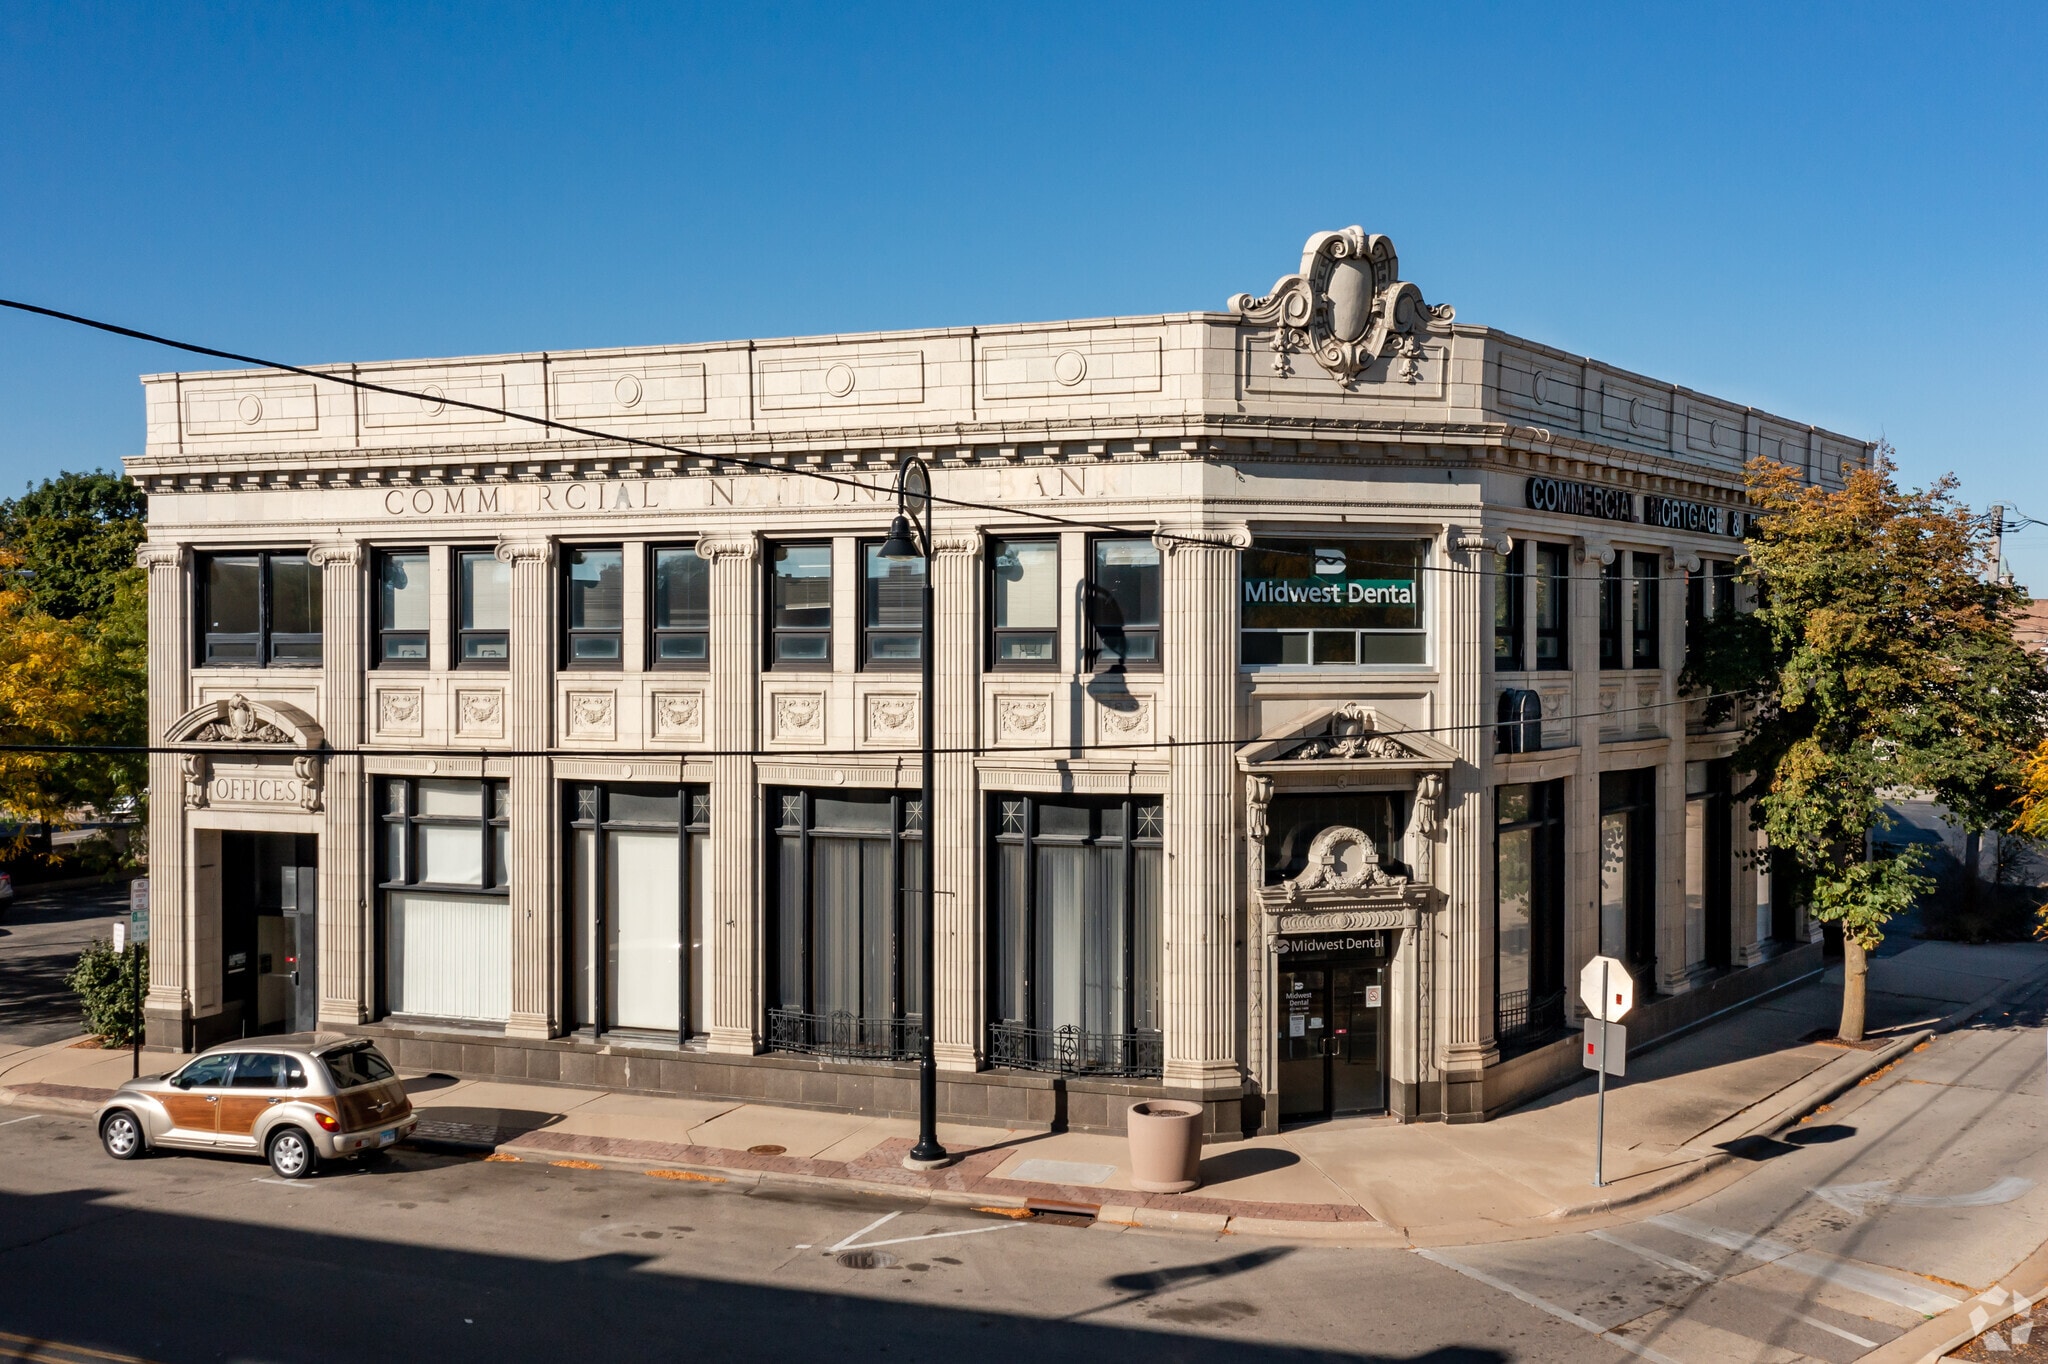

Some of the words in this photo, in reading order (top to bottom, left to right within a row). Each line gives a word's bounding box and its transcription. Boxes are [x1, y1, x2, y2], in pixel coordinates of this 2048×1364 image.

[1532, 477, 1639, 523] COMMERCIAL
[1650, 495, 1723, 534] MORTGAGE
[1245, 580, 1341, 603] Midwest
[1348, 582, 1416, 604] Dental
[216, 778, 296, 802] OFFICES
[1291, 939, 1344, 953] Midwest
[1346, 937, 1384, 950] Dental
